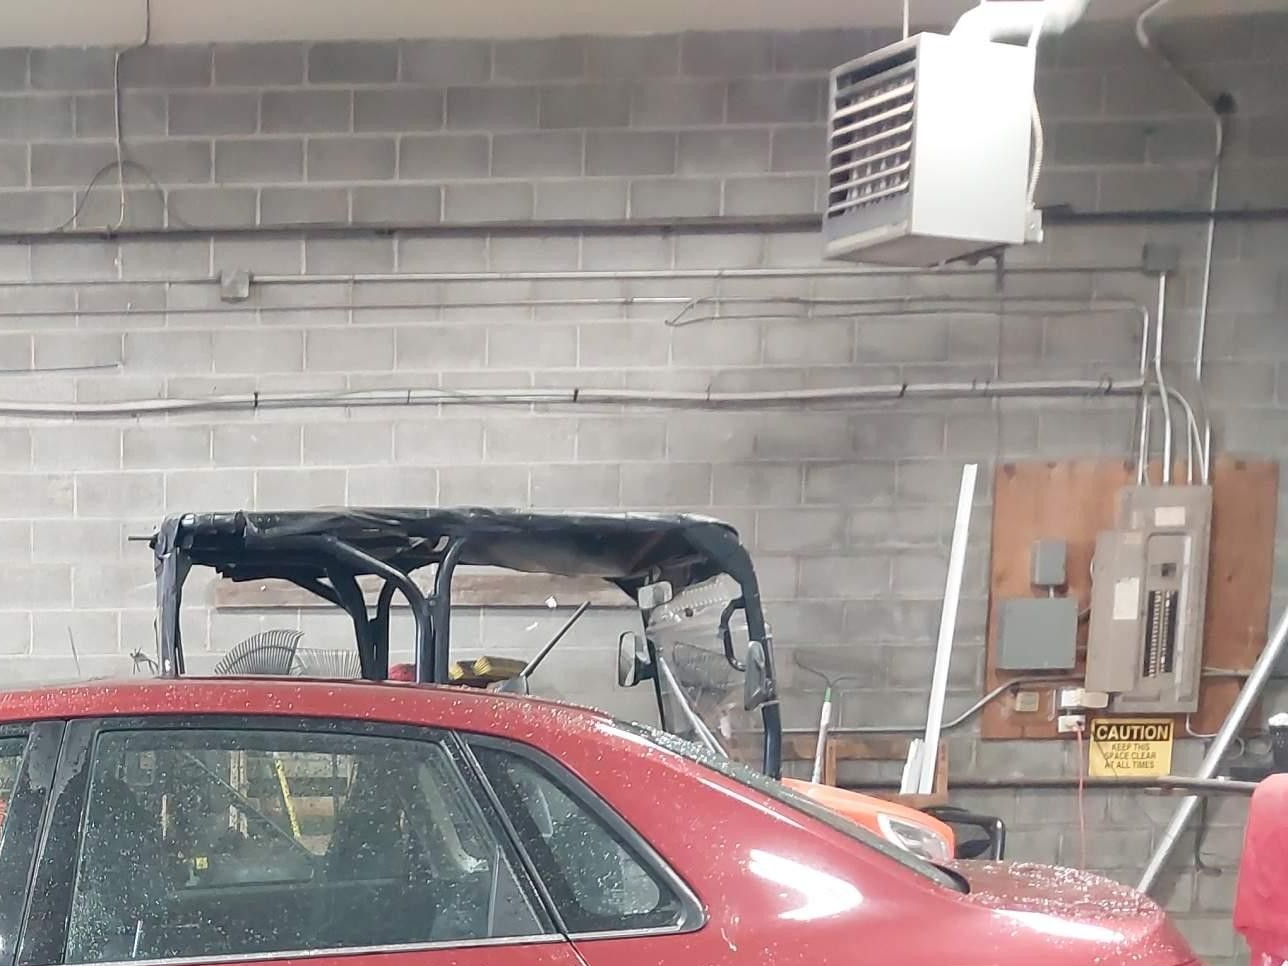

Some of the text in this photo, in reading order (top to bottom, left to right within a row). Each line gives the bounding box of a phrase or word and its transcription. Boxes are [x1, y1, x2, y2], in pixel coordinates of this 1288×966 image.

[1096, 725, 1169, 740] CAUTION
[1112, 743, 1150, 751] KEEP THIS
[1104, 752, 1157, 760] SPACE CLEAR
[1104, 761, 1154, 769] AT ALL TIMES
